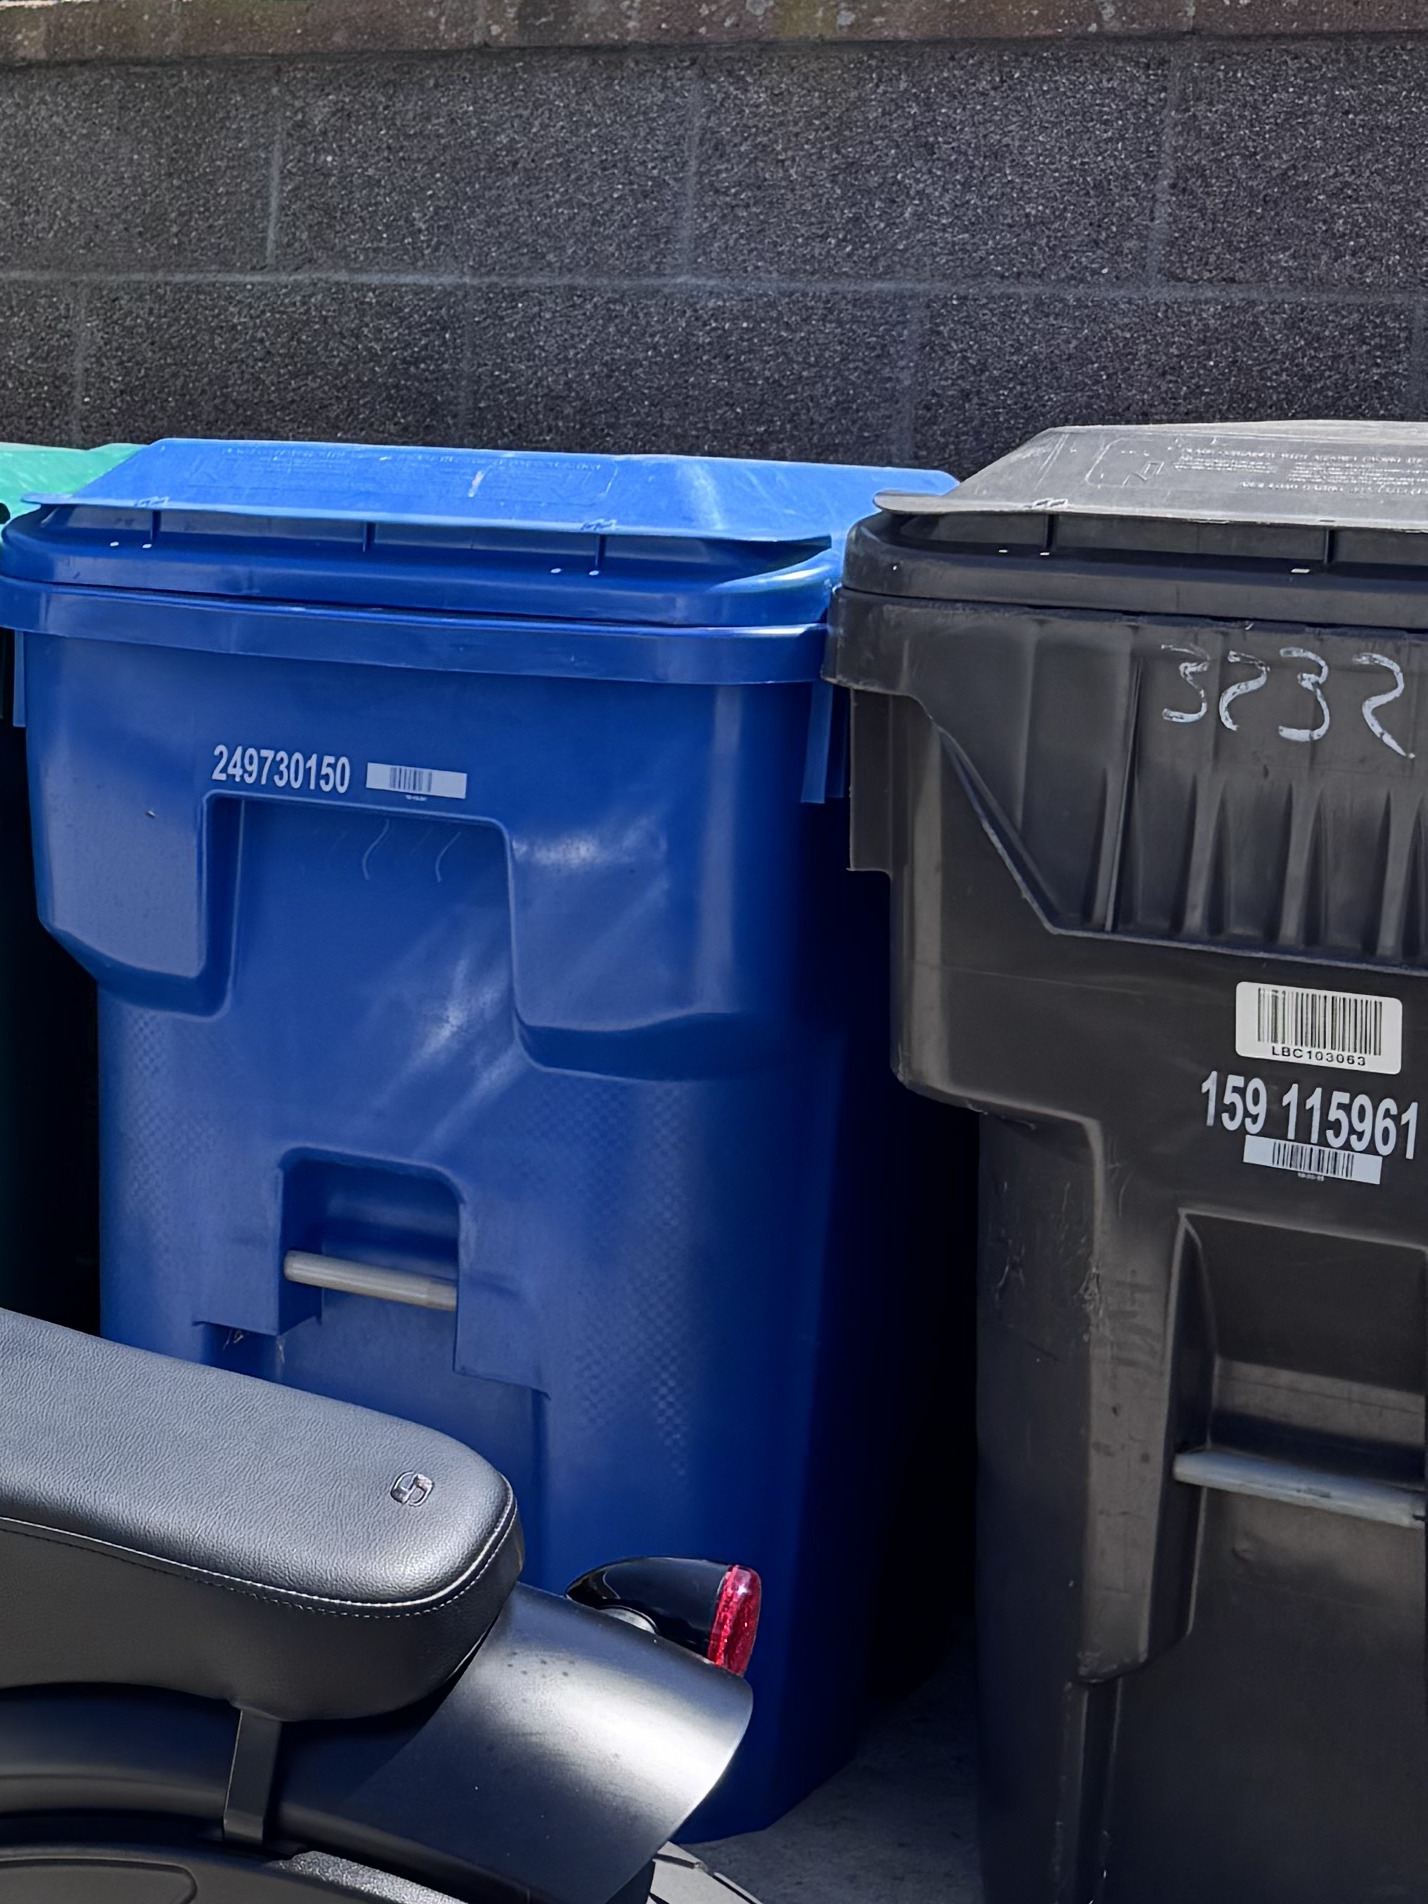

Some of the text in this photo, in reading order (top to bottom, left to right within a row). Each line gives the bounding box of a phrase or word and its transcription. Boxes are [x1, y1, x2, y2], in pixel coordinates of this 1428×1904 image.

[1160, 643, 1415, 759] 3232
[211, 744, 351, 794] 249730150
[1271, 1045, 1366, 1067] LBC103063
[1201, 1070, 1419, 1160] 159 115961
